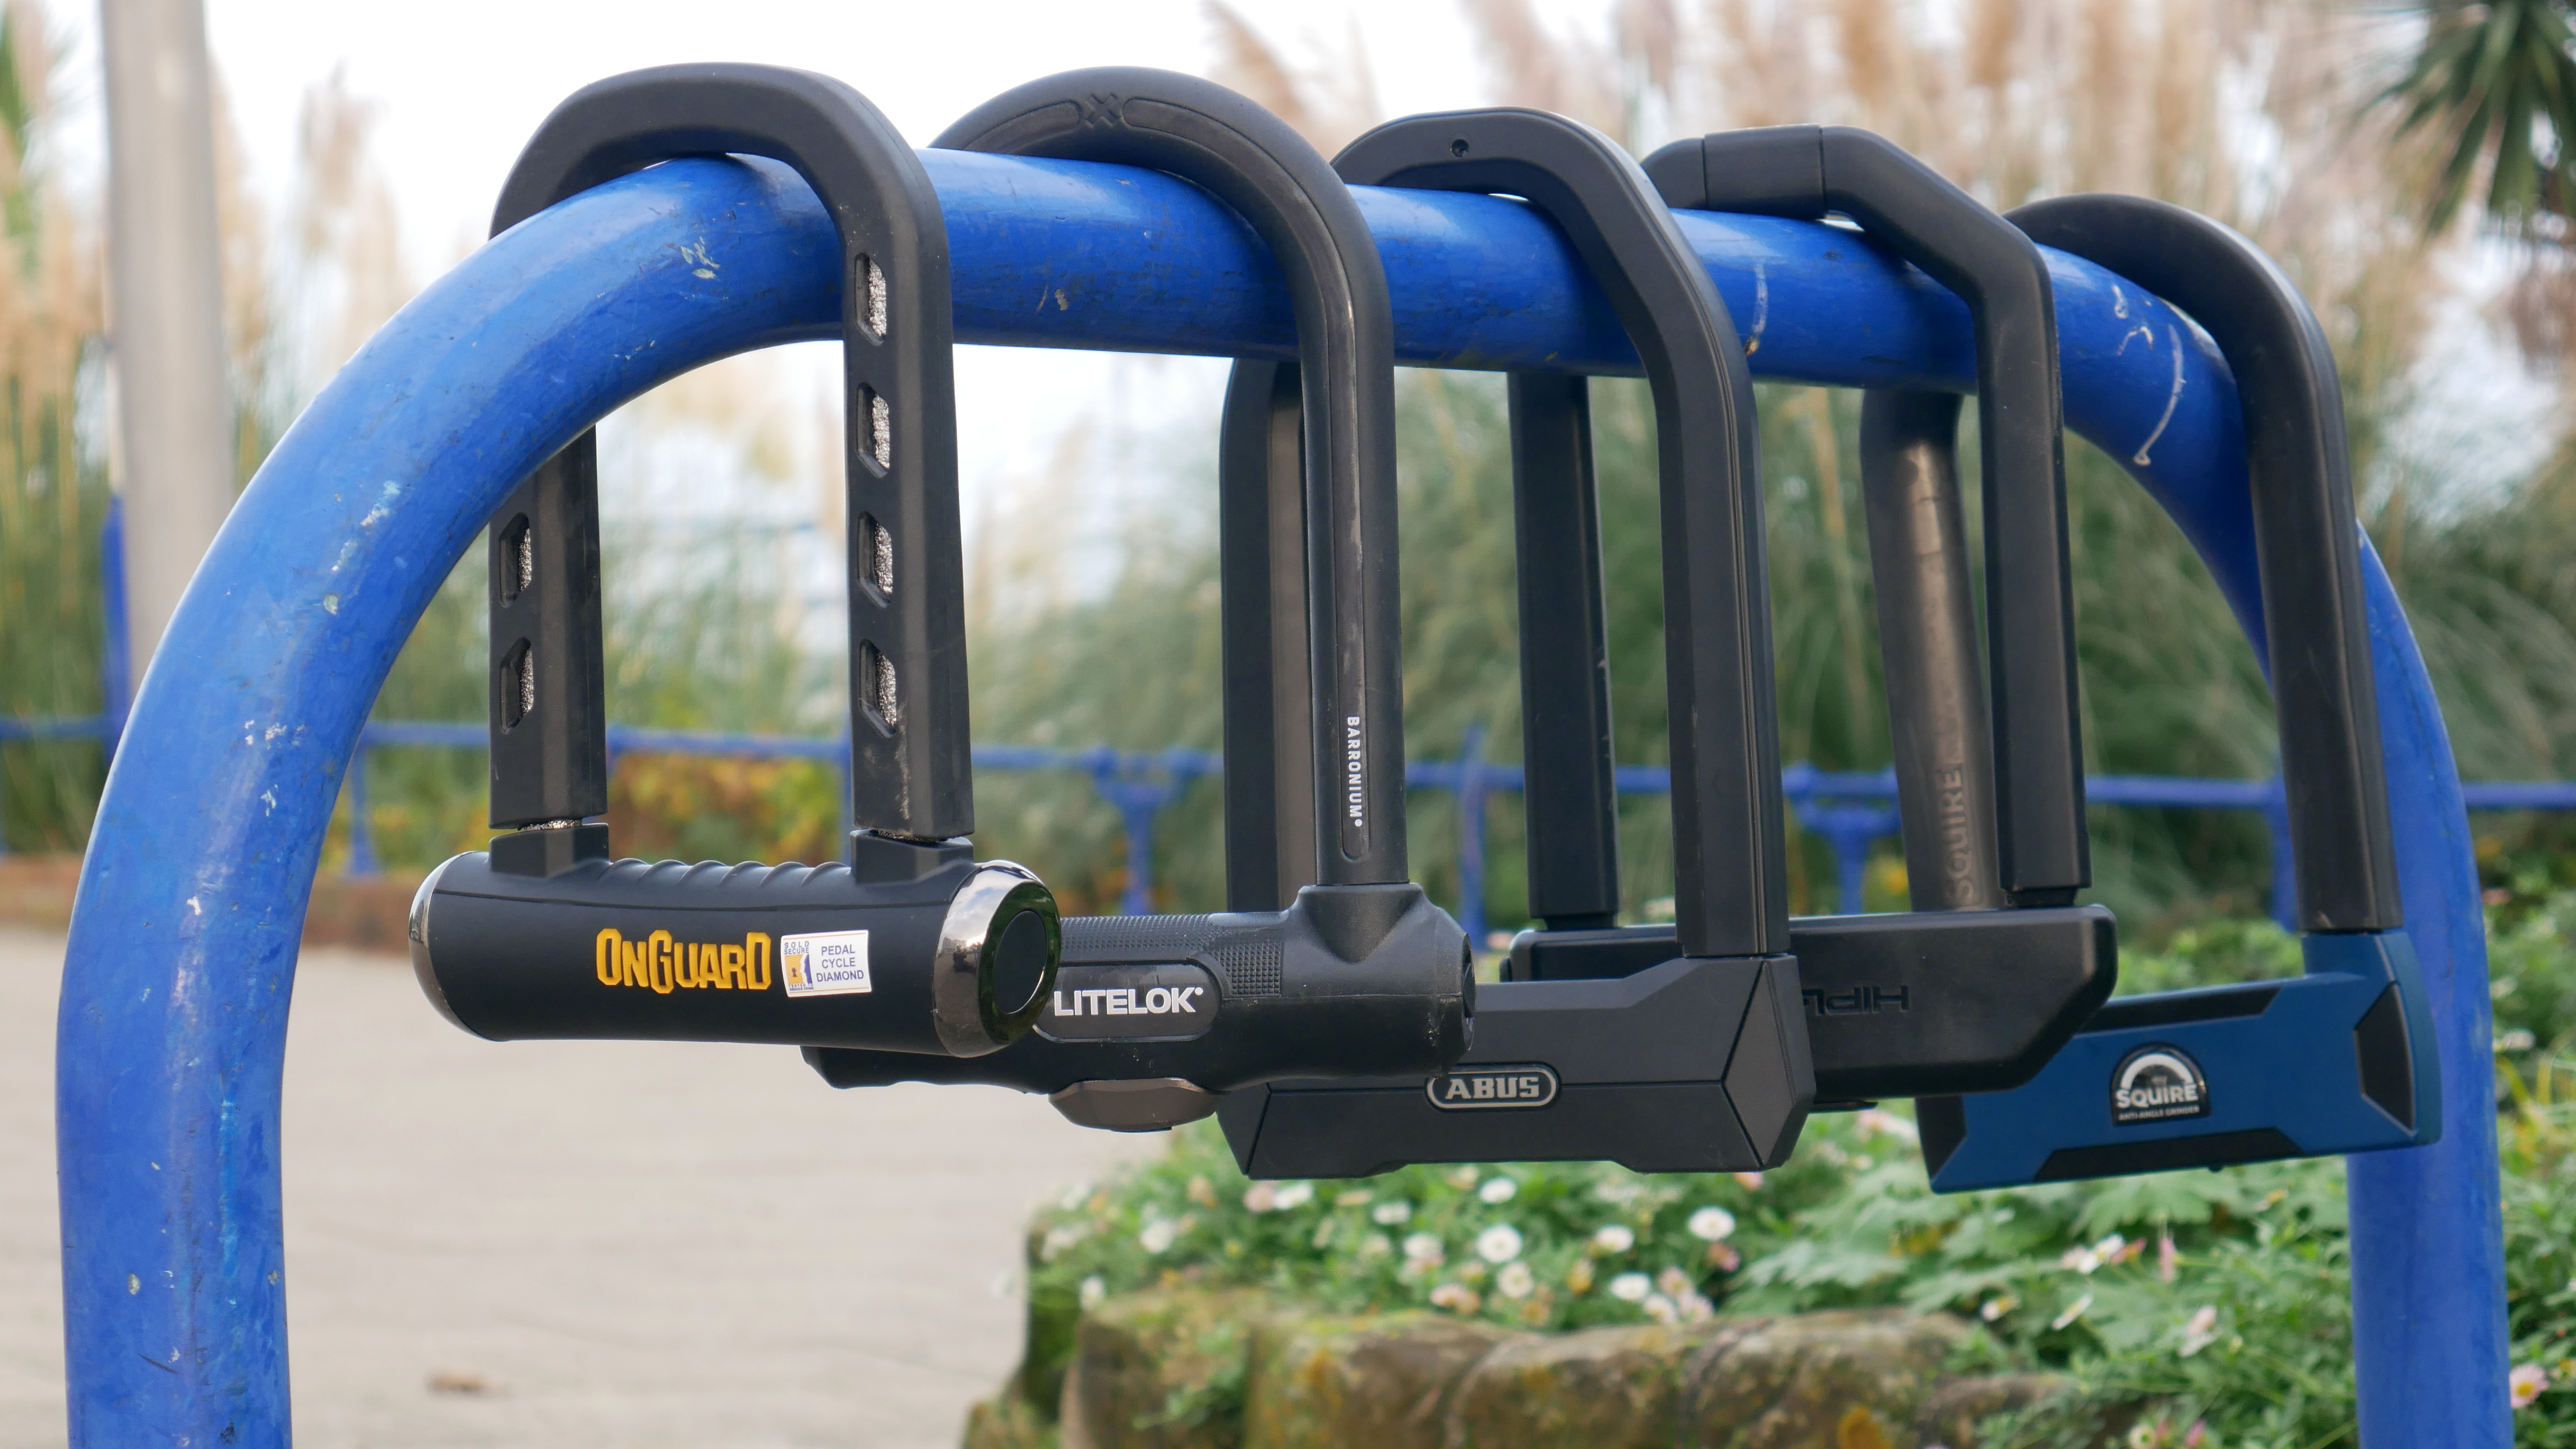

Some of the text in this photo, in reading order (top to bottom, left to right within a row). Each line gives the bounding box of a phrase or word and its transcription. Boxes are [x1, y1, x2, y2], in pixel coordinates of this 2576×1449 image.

[1347, 716, 1363, 818] BARRONIUM
[1937, 767, 1974, 901] SQUIRE
[821, 945, 855, 956] PEDAL
[821, 957, 856, 969] CYCLE
[816, 970, 864, 982] DIAMOND
[1054, 987, 1196, 1016] LITELOK
[1802, 985, 1909, 1015] HIPL
[1445, 1076, 1540, 1100] ABUS
[2115, 1083, 2199, 1108] SQUIRE
